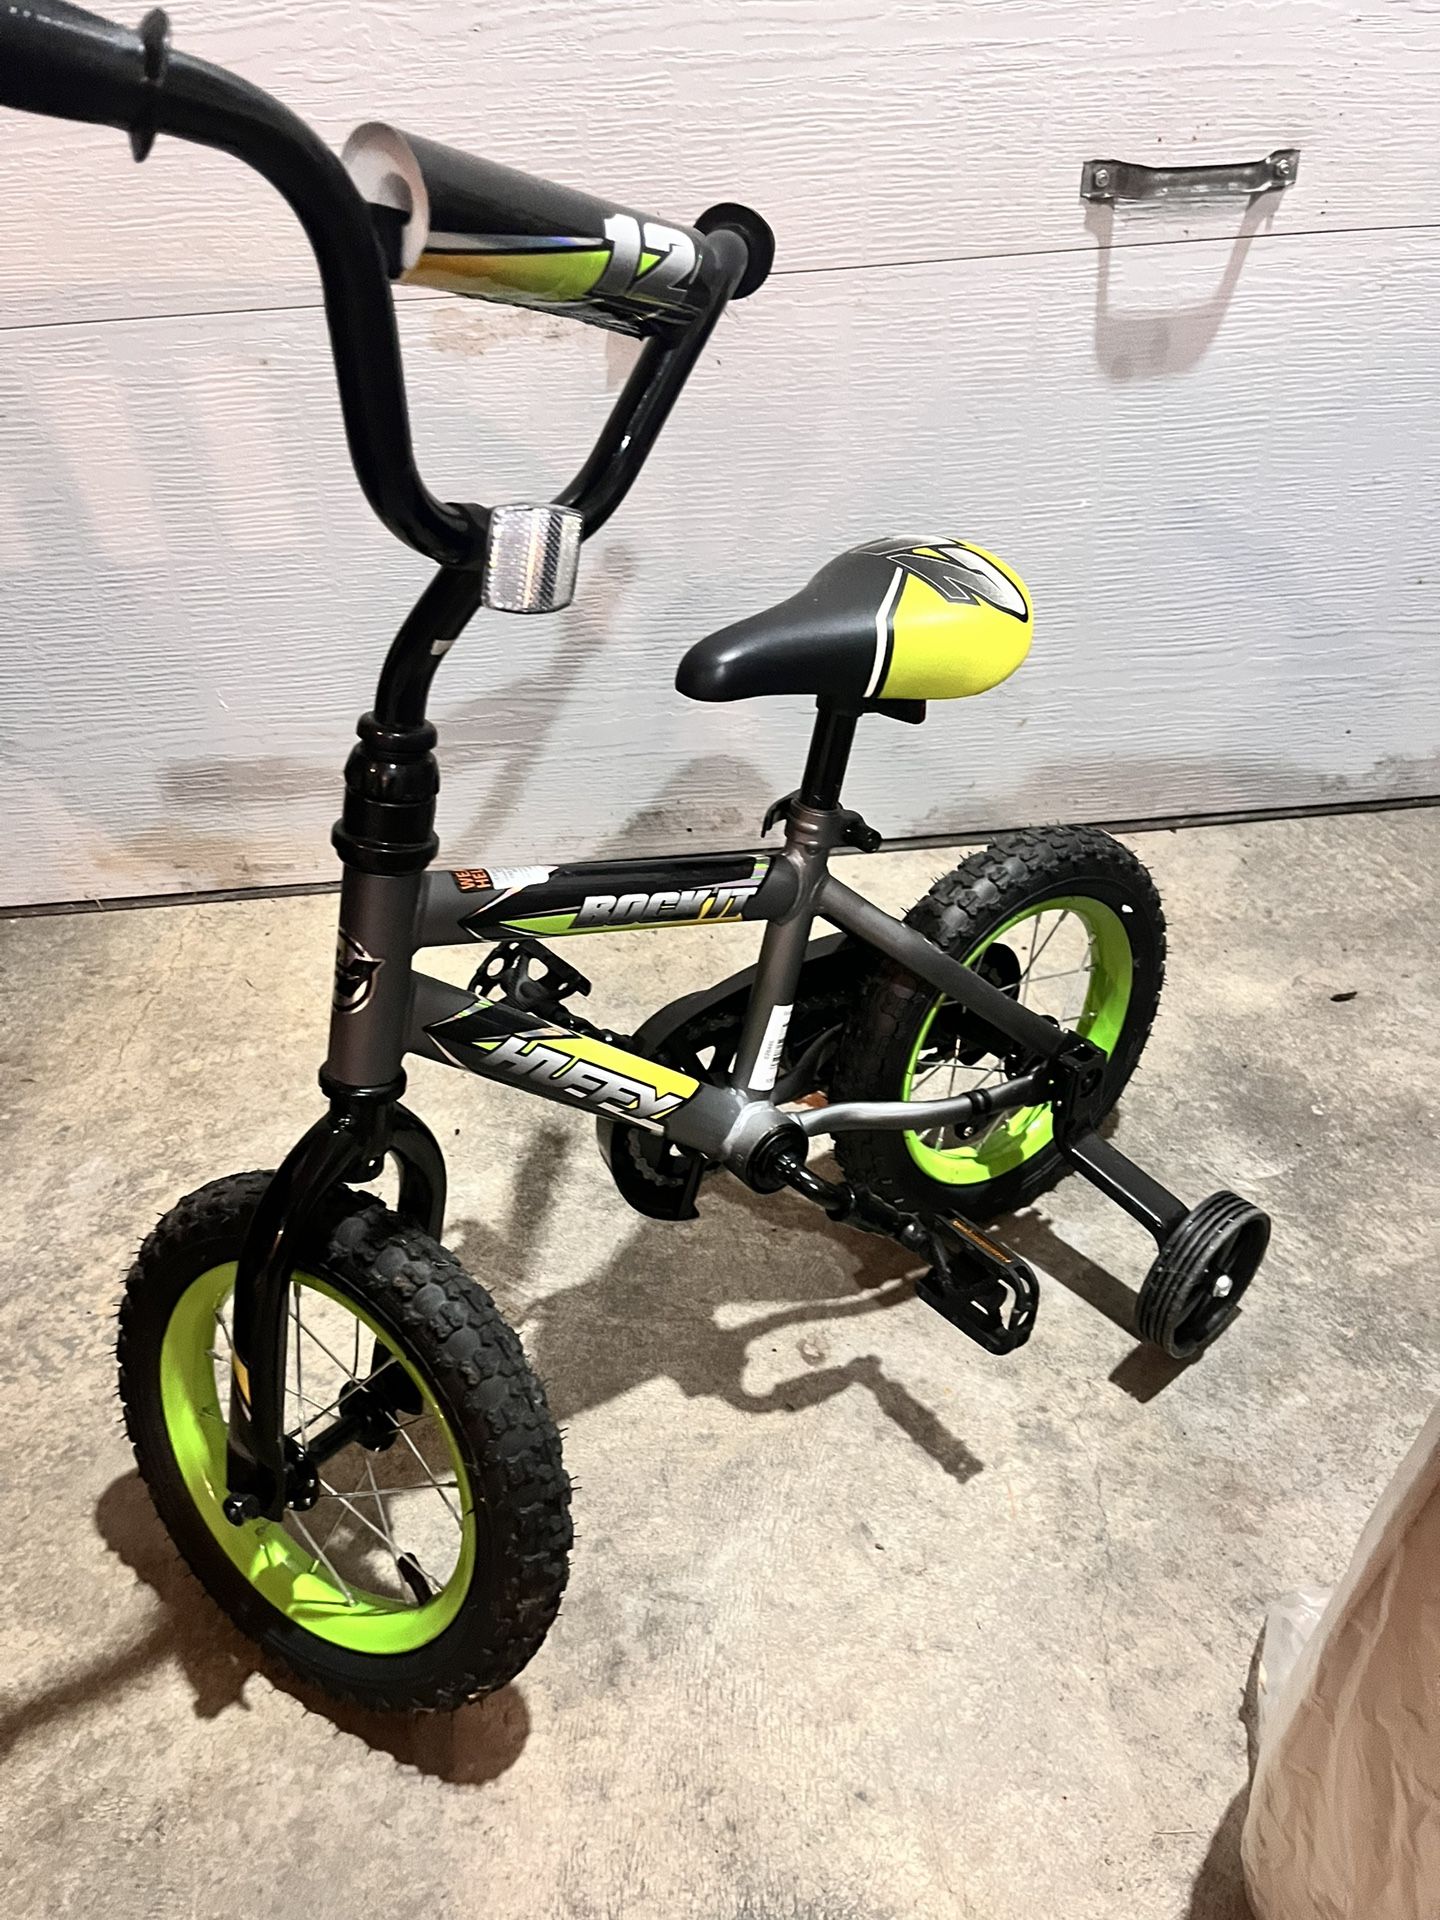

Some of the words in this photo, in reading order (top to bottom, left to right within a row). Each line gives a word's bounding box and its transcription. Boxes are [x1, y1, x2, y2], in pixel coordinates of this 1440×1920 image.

[592, 213, 696, 304] 12
[568, 887, 758, 929] ROCKIT
[482, 1036, 684, 1119] HUFFY
